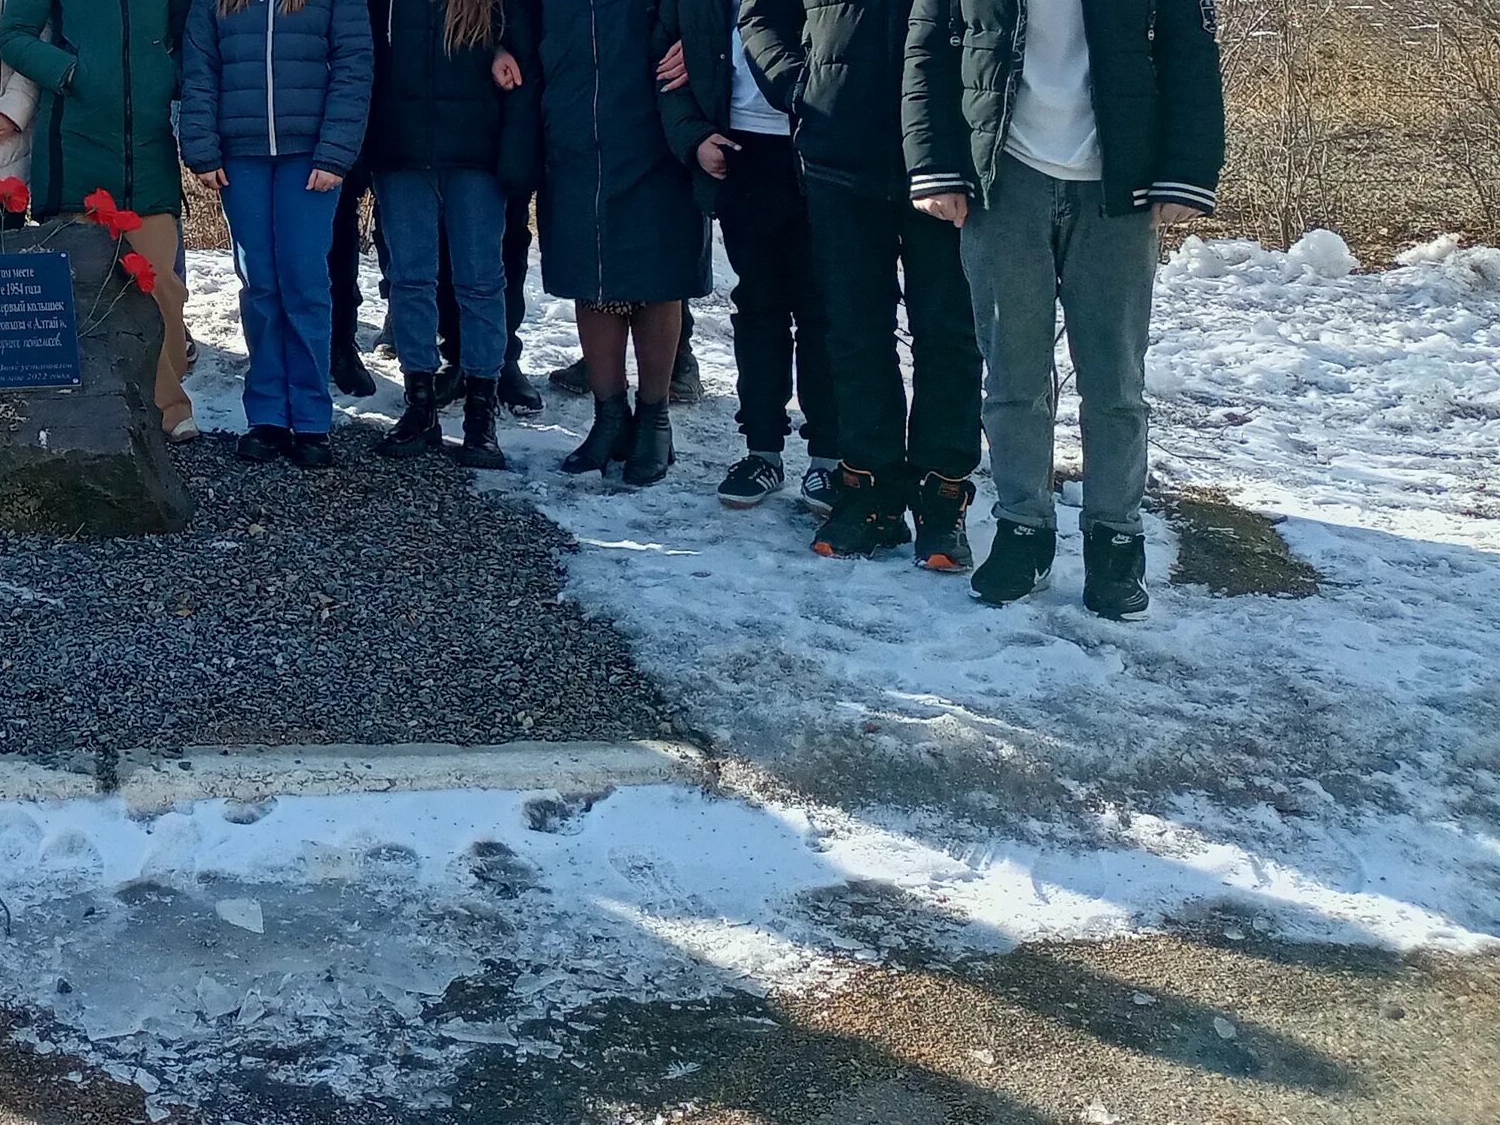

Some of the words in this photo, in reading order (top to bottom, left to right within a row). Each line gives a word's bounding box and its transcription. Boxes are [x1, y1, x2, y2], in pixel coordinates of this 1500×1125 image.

[12, 268, 35, 278] месте
[6, 282, 24, 295] 1954
[24, 285, 41, 295] года
[26, 301, 65, 313] колышек
